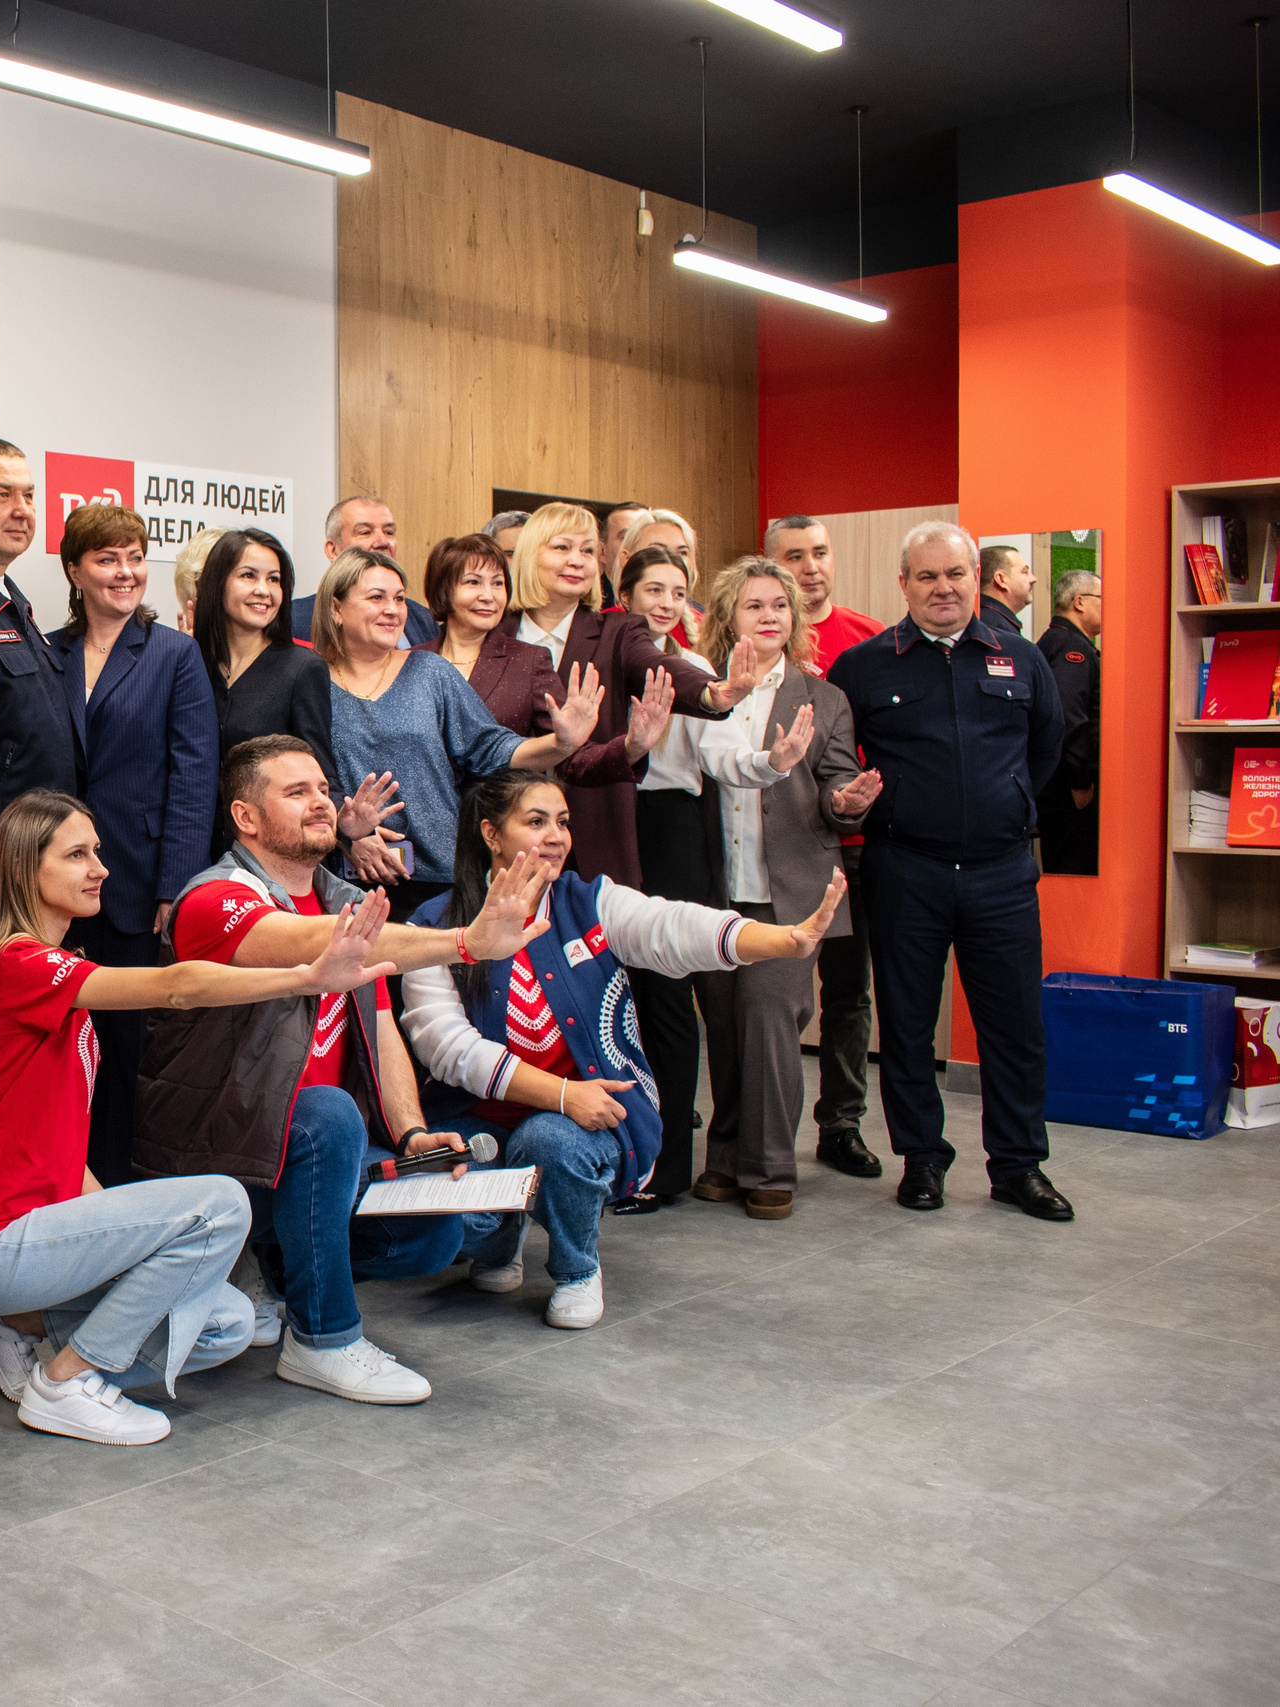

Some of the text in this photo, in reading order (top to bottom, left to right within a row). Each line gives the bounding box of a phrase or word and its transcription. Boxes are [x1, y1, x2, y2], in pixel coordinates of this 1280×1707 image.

[144, 475, 195, 507] ДЛЯ
[203, 482, 285, 516] ЛЮДЕЙ
[1167, 1023, 1189, 1034] ВТБ
